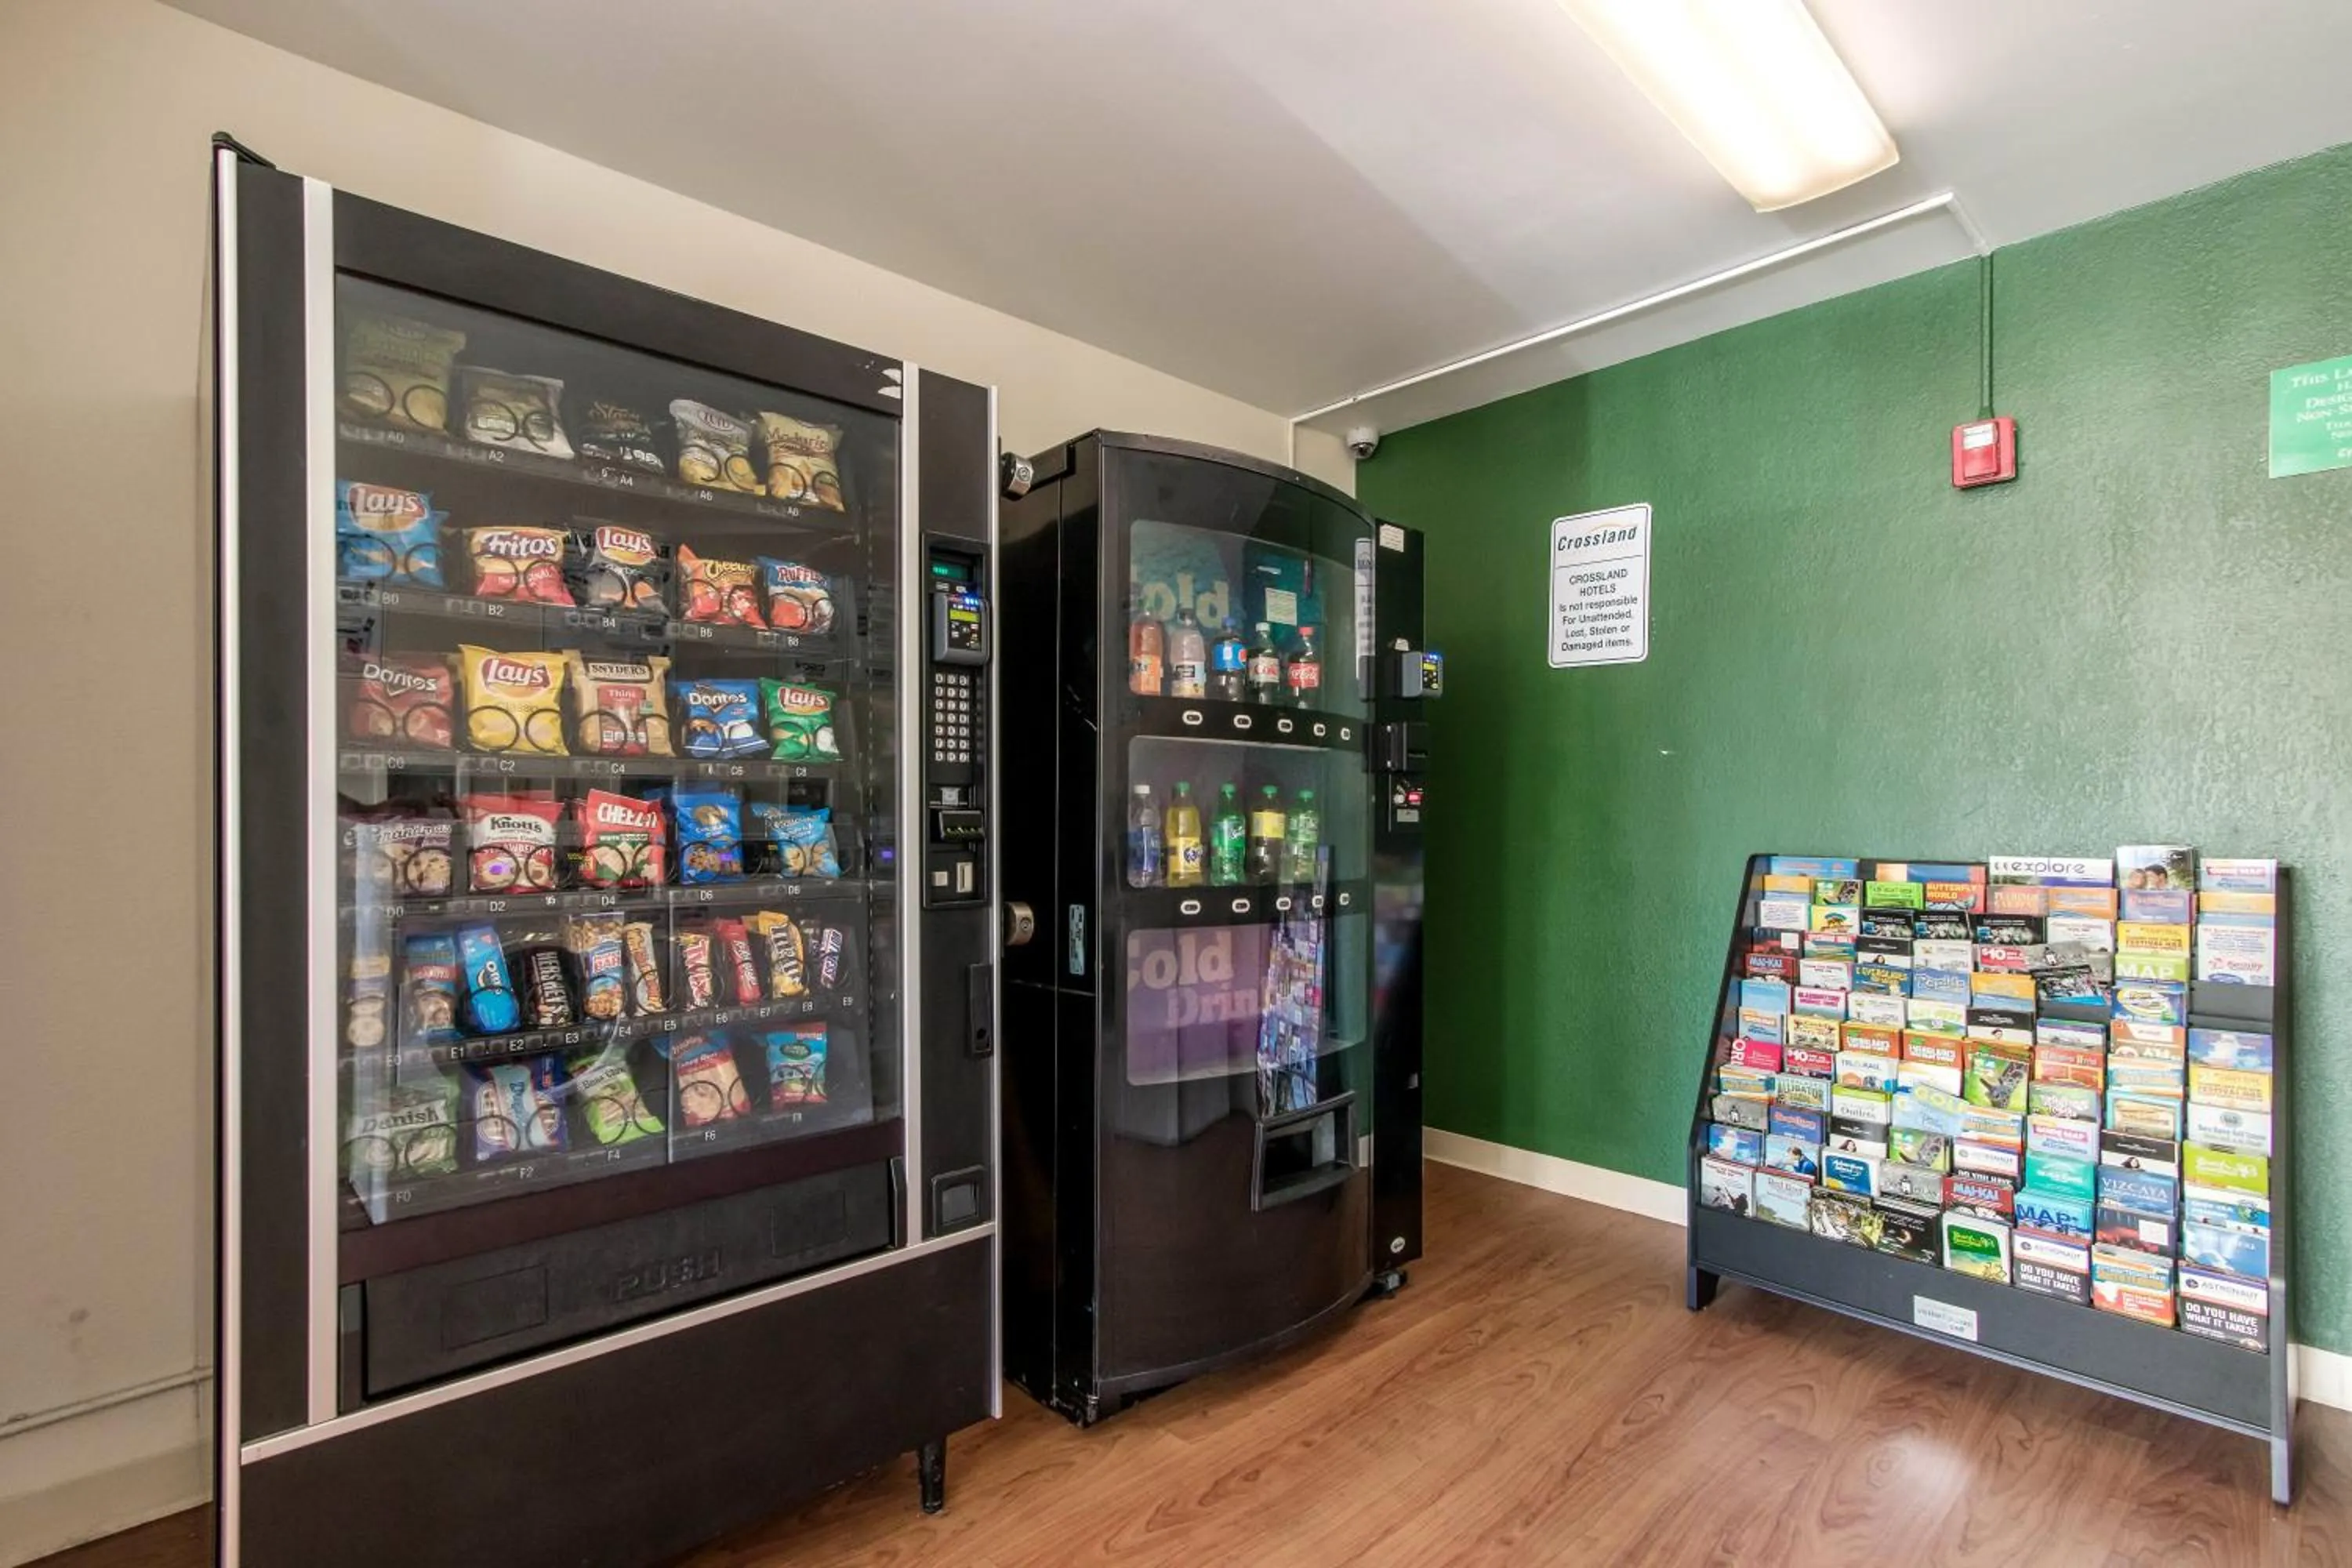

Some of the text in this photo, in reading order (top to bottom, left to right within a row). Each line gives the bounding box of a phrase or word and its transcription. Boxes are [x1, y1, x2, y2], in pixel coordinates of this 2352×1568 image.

[488, 450, 504, 463] A2
[619, 474, 633, 486] A4
[1558, 527, 1638, 550] Crossland
[1569, 568, 1628, 585] CROSSLAND
[1580, 583, 1617, 597] HOTELS
[1131, 573, 1229, 628] old
[1569, 601, 1583, 612] not
[1585, 596, 1638, 612] responsible
[488, 604, 504, 617] B2
[1563, 615, 1576, 625] For
[1590, 626, 1617, 636] Stolen
[1562, 639, 1603, 652] Damaged
[487, 659, 546, 686] Lay's
[689, 691, 747, 706] Doritos
[499, 760, 515, 771] C2
[612, 764, 625, 774] C4
[491, 816, 543, 833] Knott's
[601, 895, 615, 906] D4
[700, 891, 713, 901] D6
[490, 902, 506, 912] D2
[2115, 964, 2176, 979] MAP
[1167, 982, 1259, 1029] Drin
[760, 1007, 771, 1017] E7
[716, 1014, 728, 1024] E6
[619, 1025, 631, 1036] E4
[664, 1020, 677, 1031] E5
[565, 1033, 579, 1044] E3
[510, 1040, 524, 1051] E2
[451, 1047, 464, 1058] E1
[362, 1106, 440, 1134] Danish
[705, 1130, 717, 1141] F6
[608, 1149, 621, 1160] F4
[520, 1167, 533, 1178] F2
[2102, 1178, 2168, 1199] VIZCAYA
[2020, 1263, 2081, 1284] DO YOU HAVE
[2186, 1301, 2259, 1325] DO YOU HAVE
[2186, 1312, 2259, 1337] WHAT IT TAKES?
